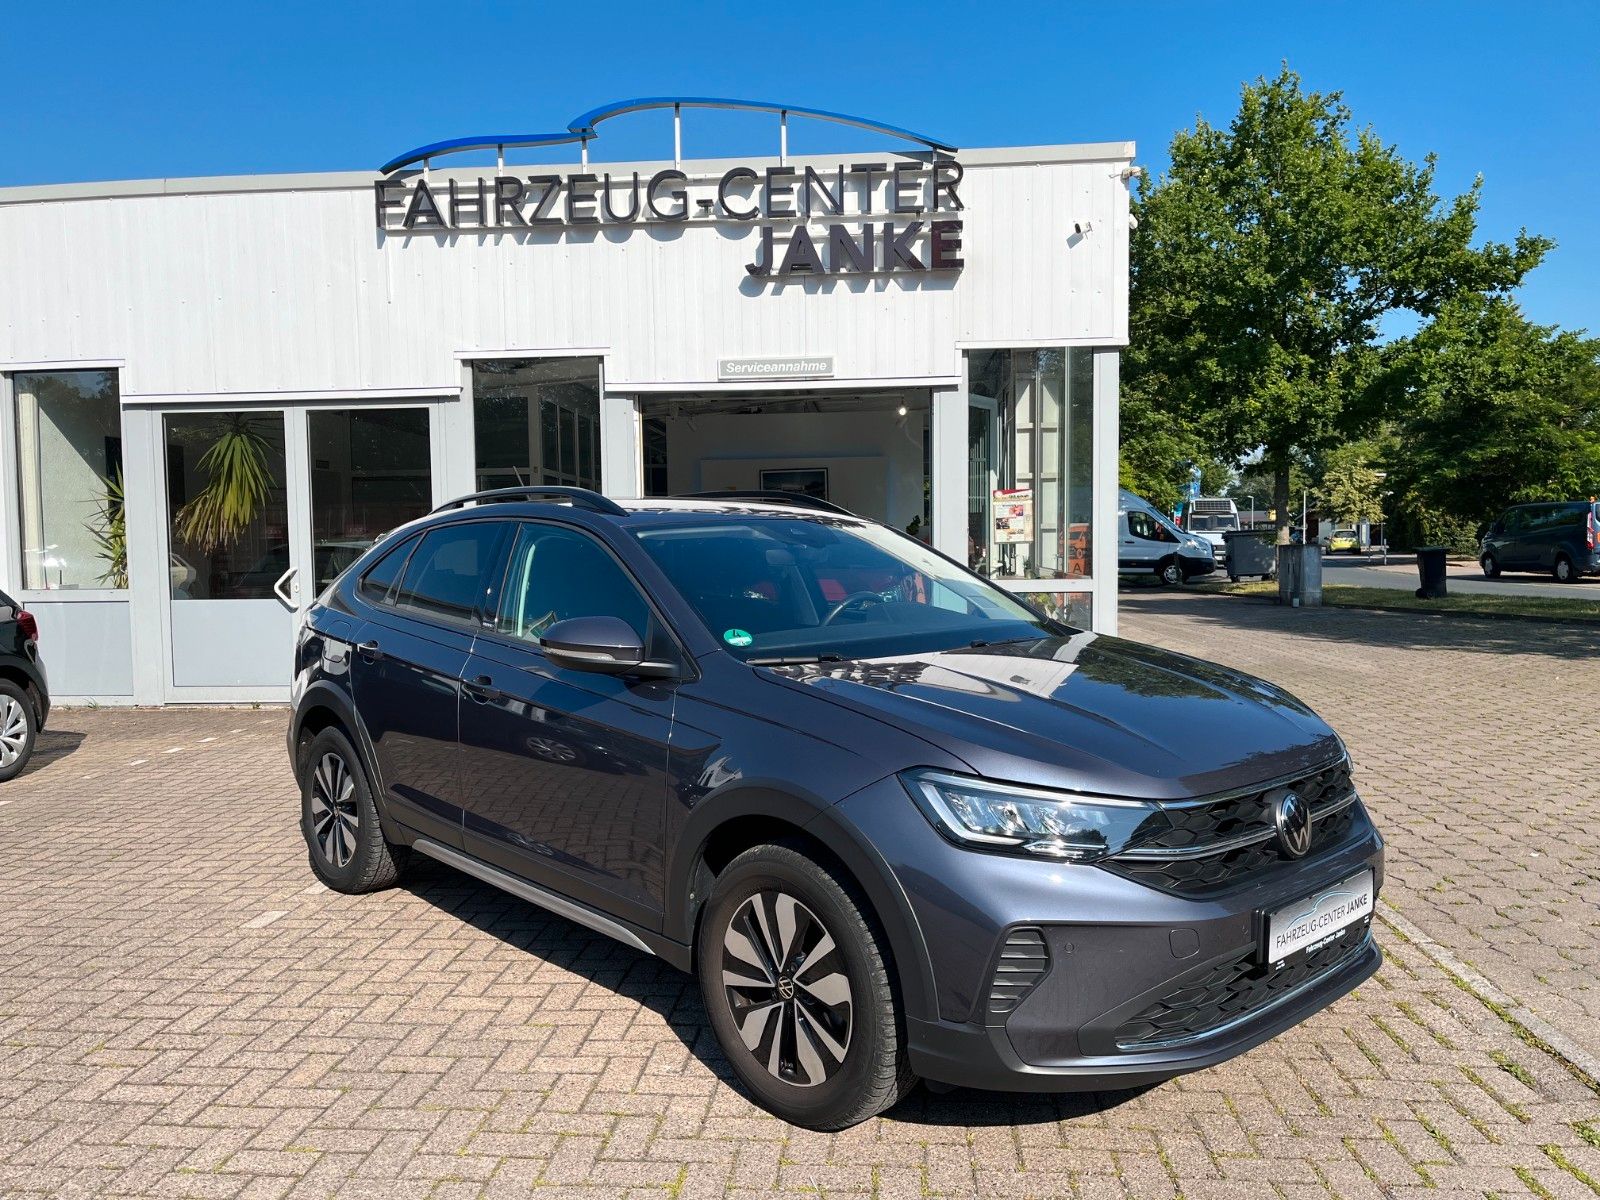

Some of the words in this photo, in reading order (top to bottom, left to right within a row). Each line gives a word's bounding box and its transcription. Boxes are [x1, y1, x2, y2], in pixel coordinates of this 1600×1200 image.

[374, 160, 965, 230] FAHRZEUG-CENTER
[745, 220, 965, 278] JANKE
[726, 361, 827, 373] Serviceannahme
[1276, 906, 1346, 949] FAHRZEUG-CENTER
[1346, 893, 1368, 915] JANKE
